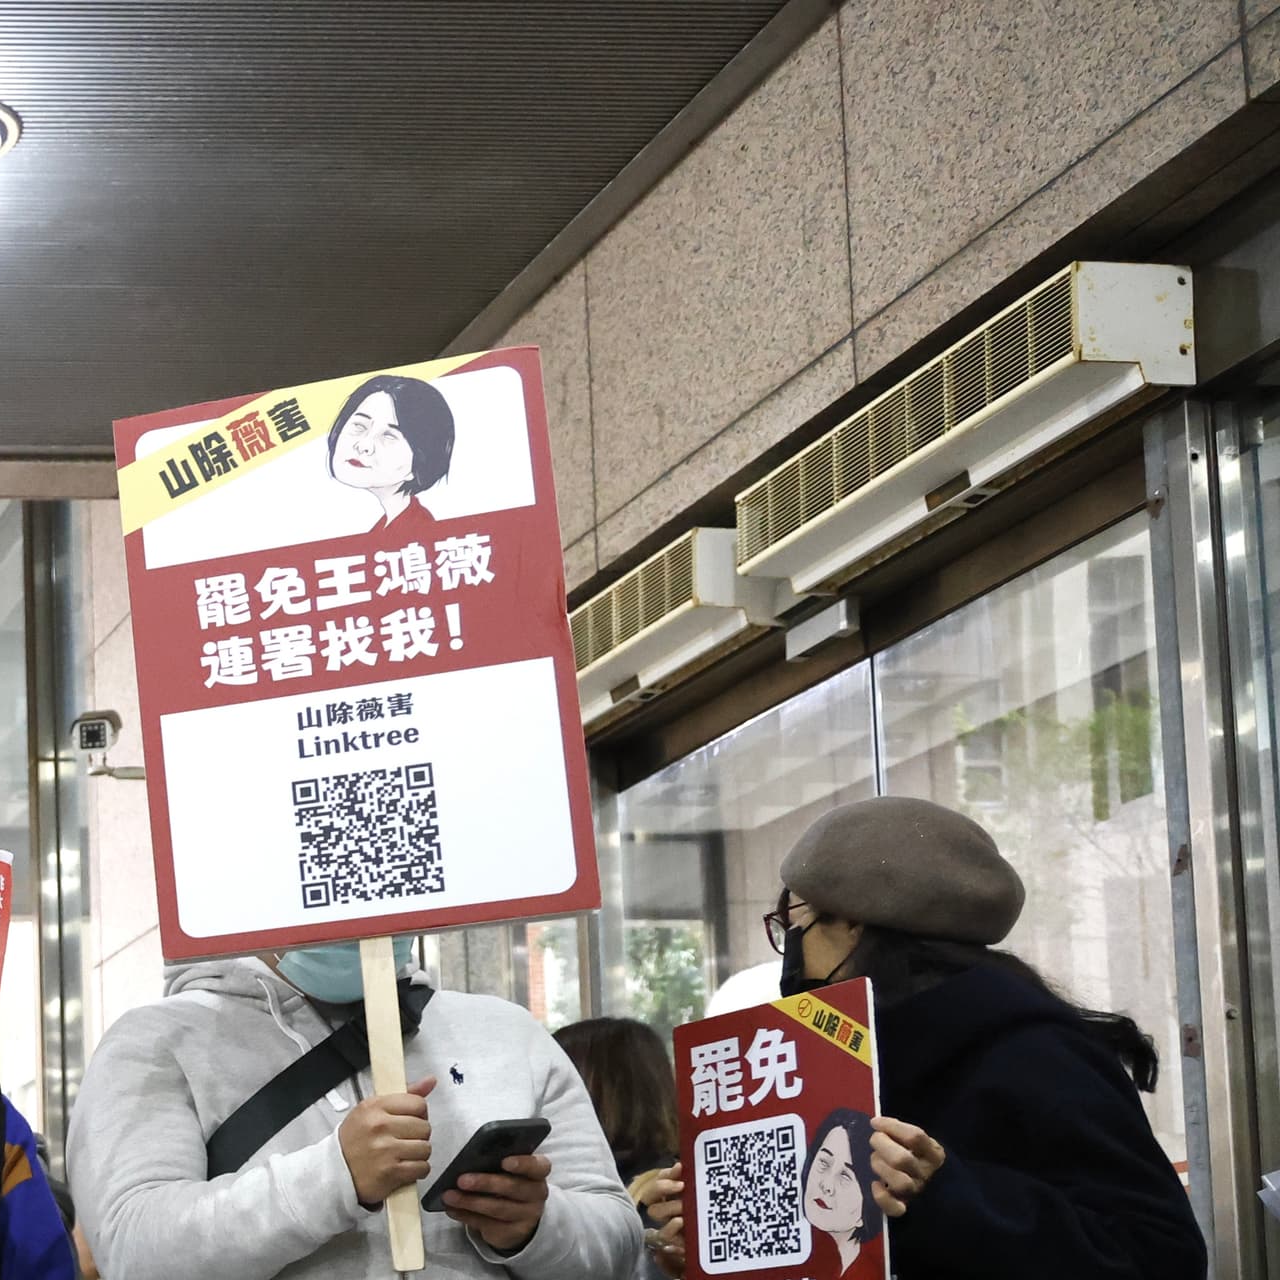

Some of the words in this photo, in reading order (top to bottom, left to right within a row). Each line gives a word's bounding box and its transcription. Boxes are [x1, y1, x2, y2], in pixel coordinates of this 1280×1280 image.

[159, 398, 311, 499] 山除薇害
[194, 533, 495, 630] 罷免王鴻薇
[200, 603, 464, 688] 連署找我!
[296, 692, 414, 731] 山除薇害
[298, 727, 420, 759] Linktree
[690, 1028, 804, 1119] 罷免
[813, 1009, 865, 1053] 山除薇害
